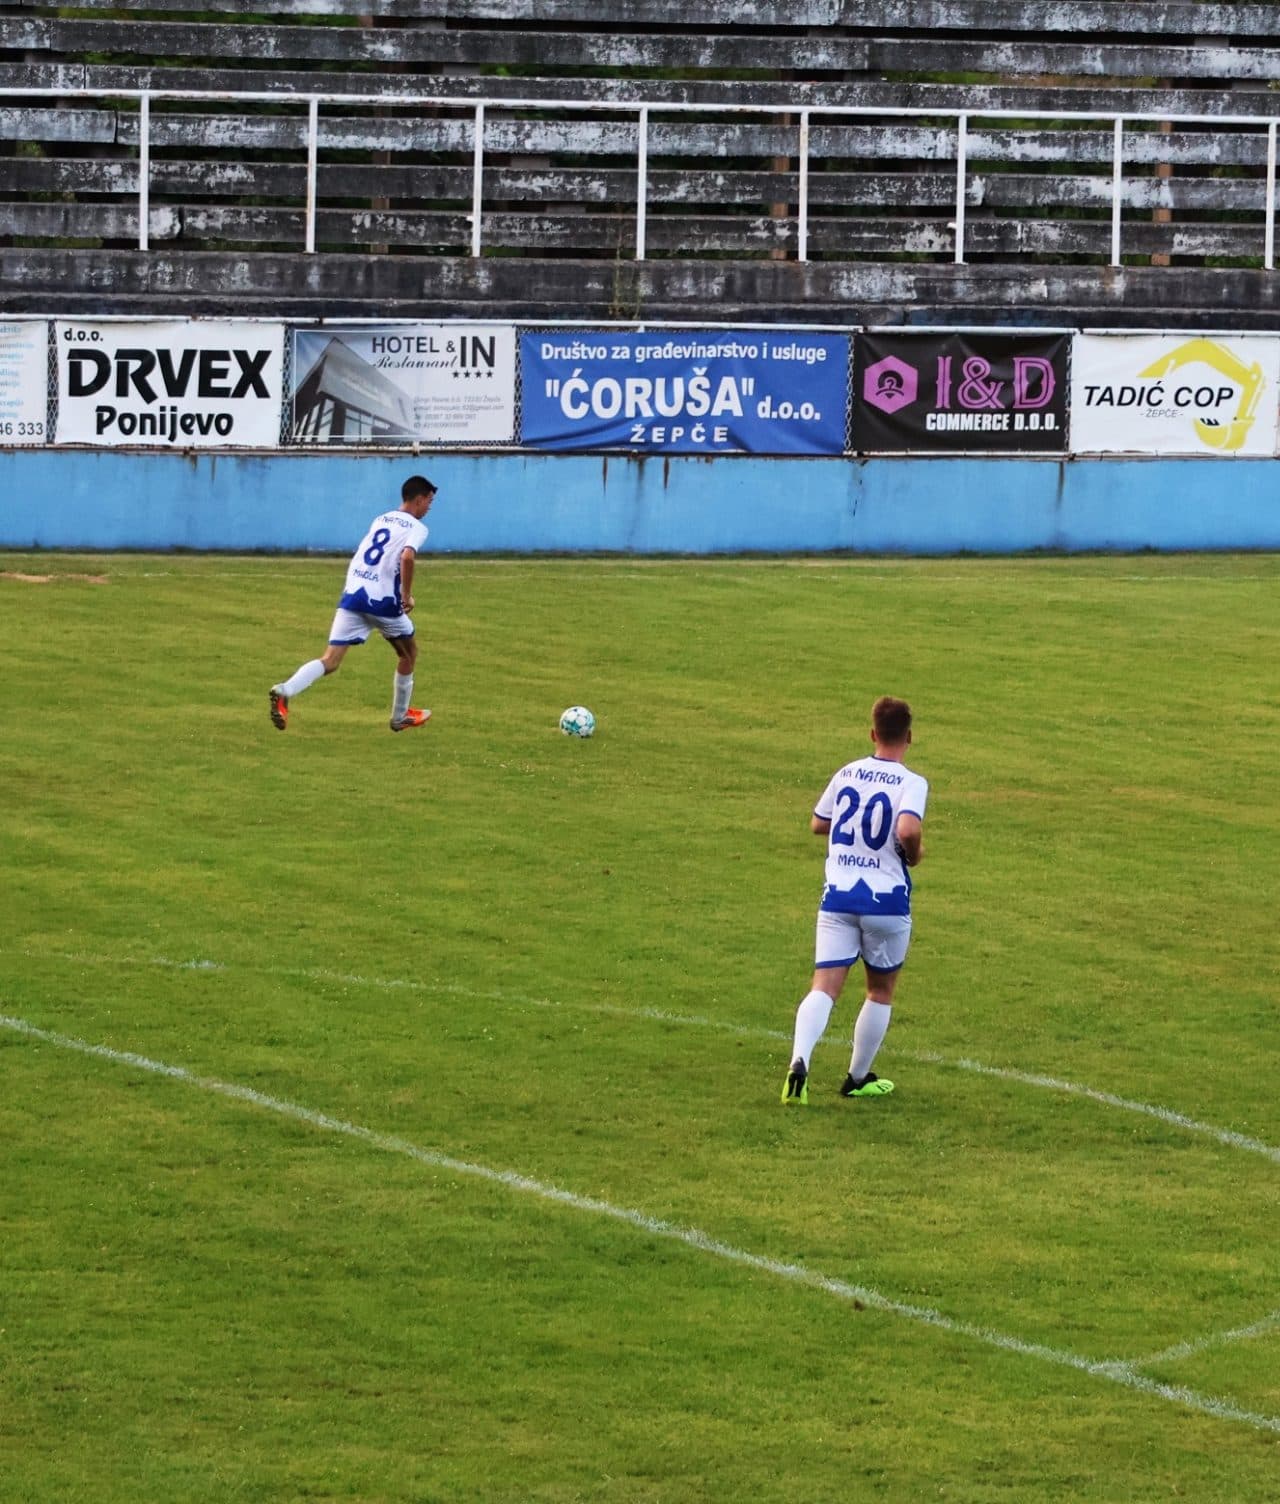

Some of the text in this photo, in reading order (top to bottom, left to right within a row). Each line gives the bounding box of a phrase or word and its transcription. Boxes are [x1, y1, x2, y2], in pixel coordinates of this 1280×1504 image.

[64, 328, 103, 341] d.o.o.
[372, 336, 496, 368] HOTEL & IN
[373, 355, 458, 369] Restaurant
[541, 341, 827, 364] Društvo za građevinarstvo i usluge
[67, 348, 272, 404] DRVEX
[545, 367, 821, 420] "ĆORUŠA" d.o.o.
[1084, 380, 1234, 407] TADIĆ COP
[18, 422, 43, 435] 333
[95, 405, 234, 442] Ponijevo
[630, 423, 728, 443] ŽEPČE
[926, 413, 1059, 431] COMMERCE D.O.O.
[364, 528, 390, 566] 8
[855, 768, 904, 785] NATRON
[832, 786, 893, 850] 20
